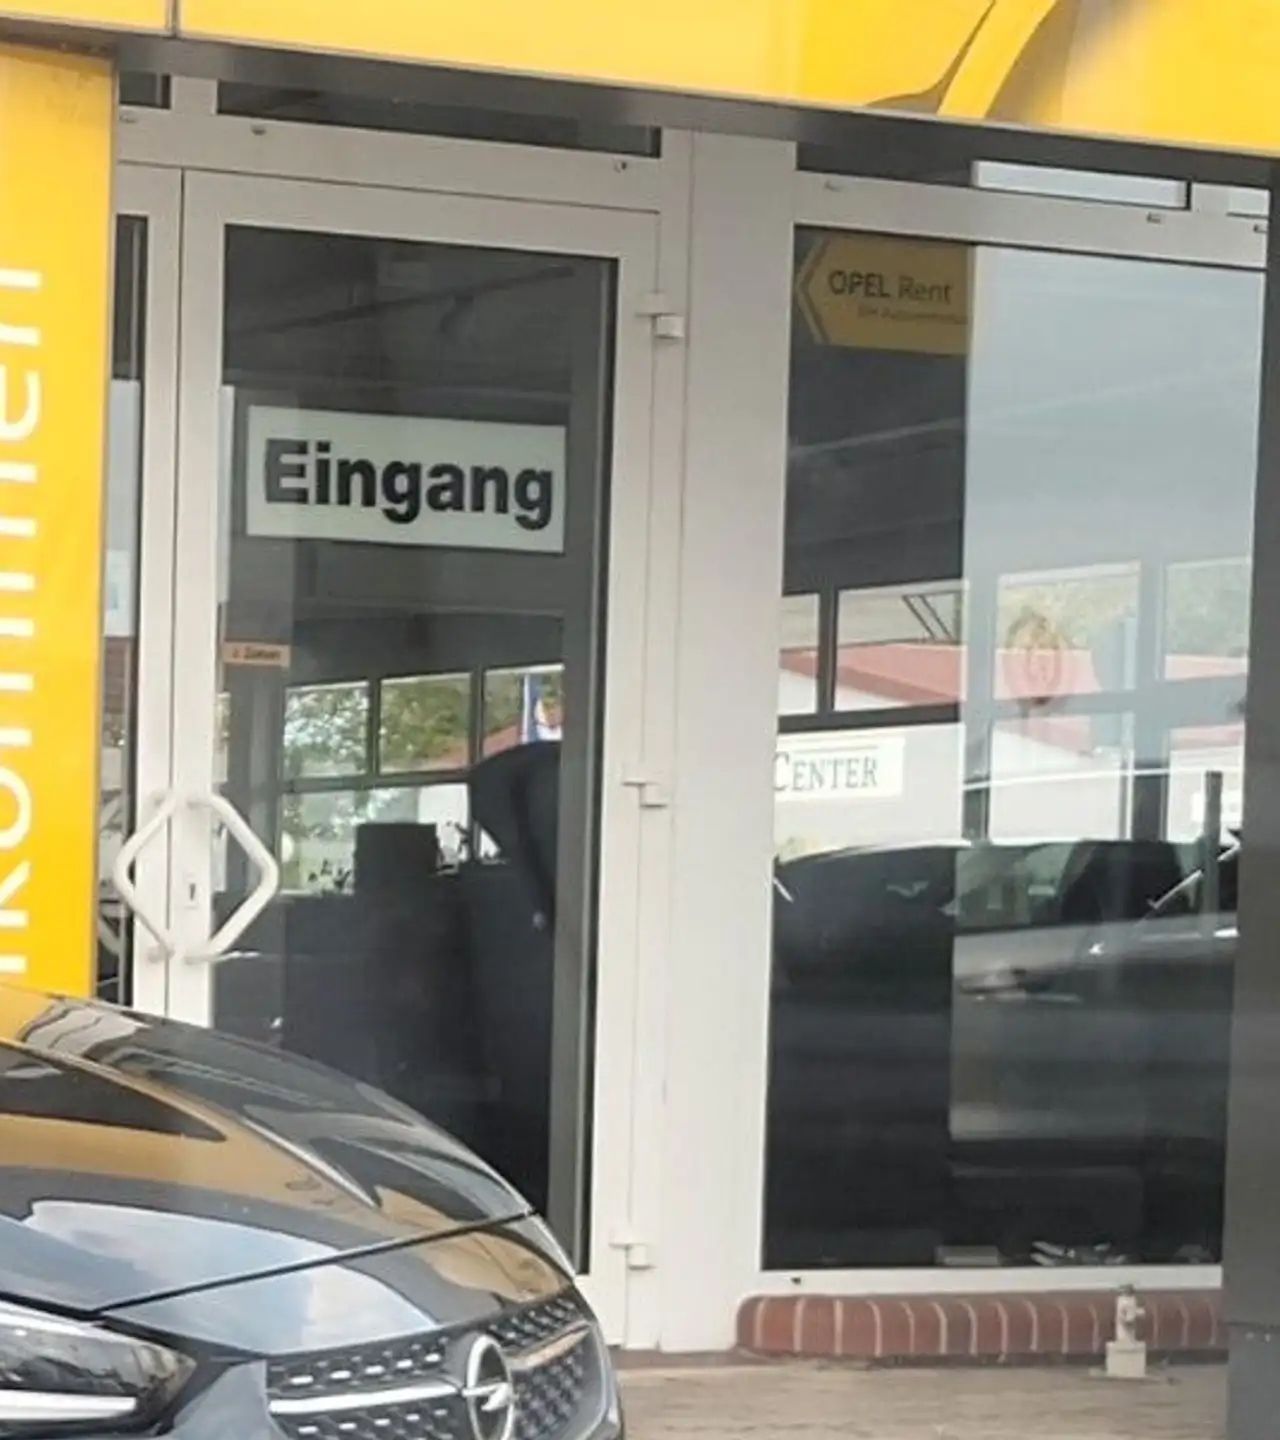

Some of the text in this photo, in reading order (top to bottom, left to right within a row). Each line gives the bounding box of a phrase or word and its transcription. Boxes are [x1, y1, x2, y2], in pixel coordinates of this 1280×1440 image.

[828, 270, 954, 304] OPEL Rent
[265, 438, 552, 530] Eingang
